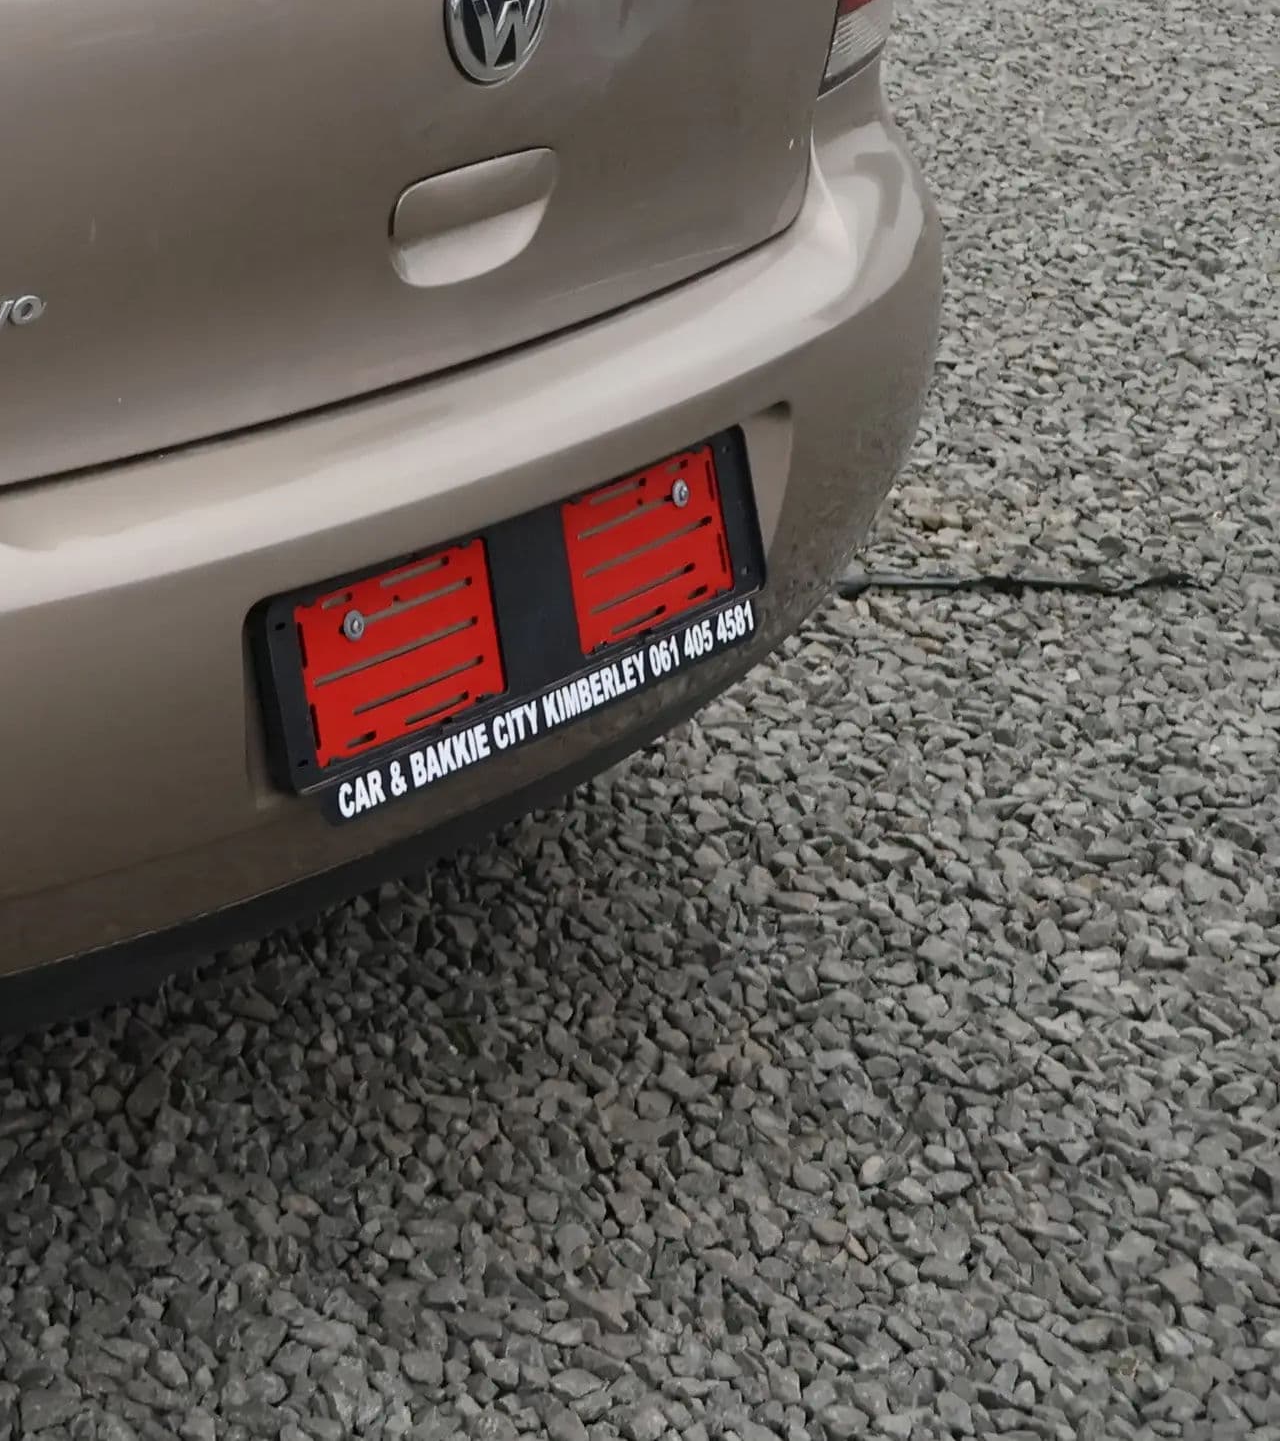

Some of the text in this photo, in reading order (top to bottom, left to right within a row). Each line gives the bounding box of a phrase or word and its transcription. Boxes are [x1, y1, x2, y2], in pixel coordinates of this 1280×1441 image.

[338, 599, 755, 818] CAR & BAKKIE CITY KIMBERLEY 061 405 4581
